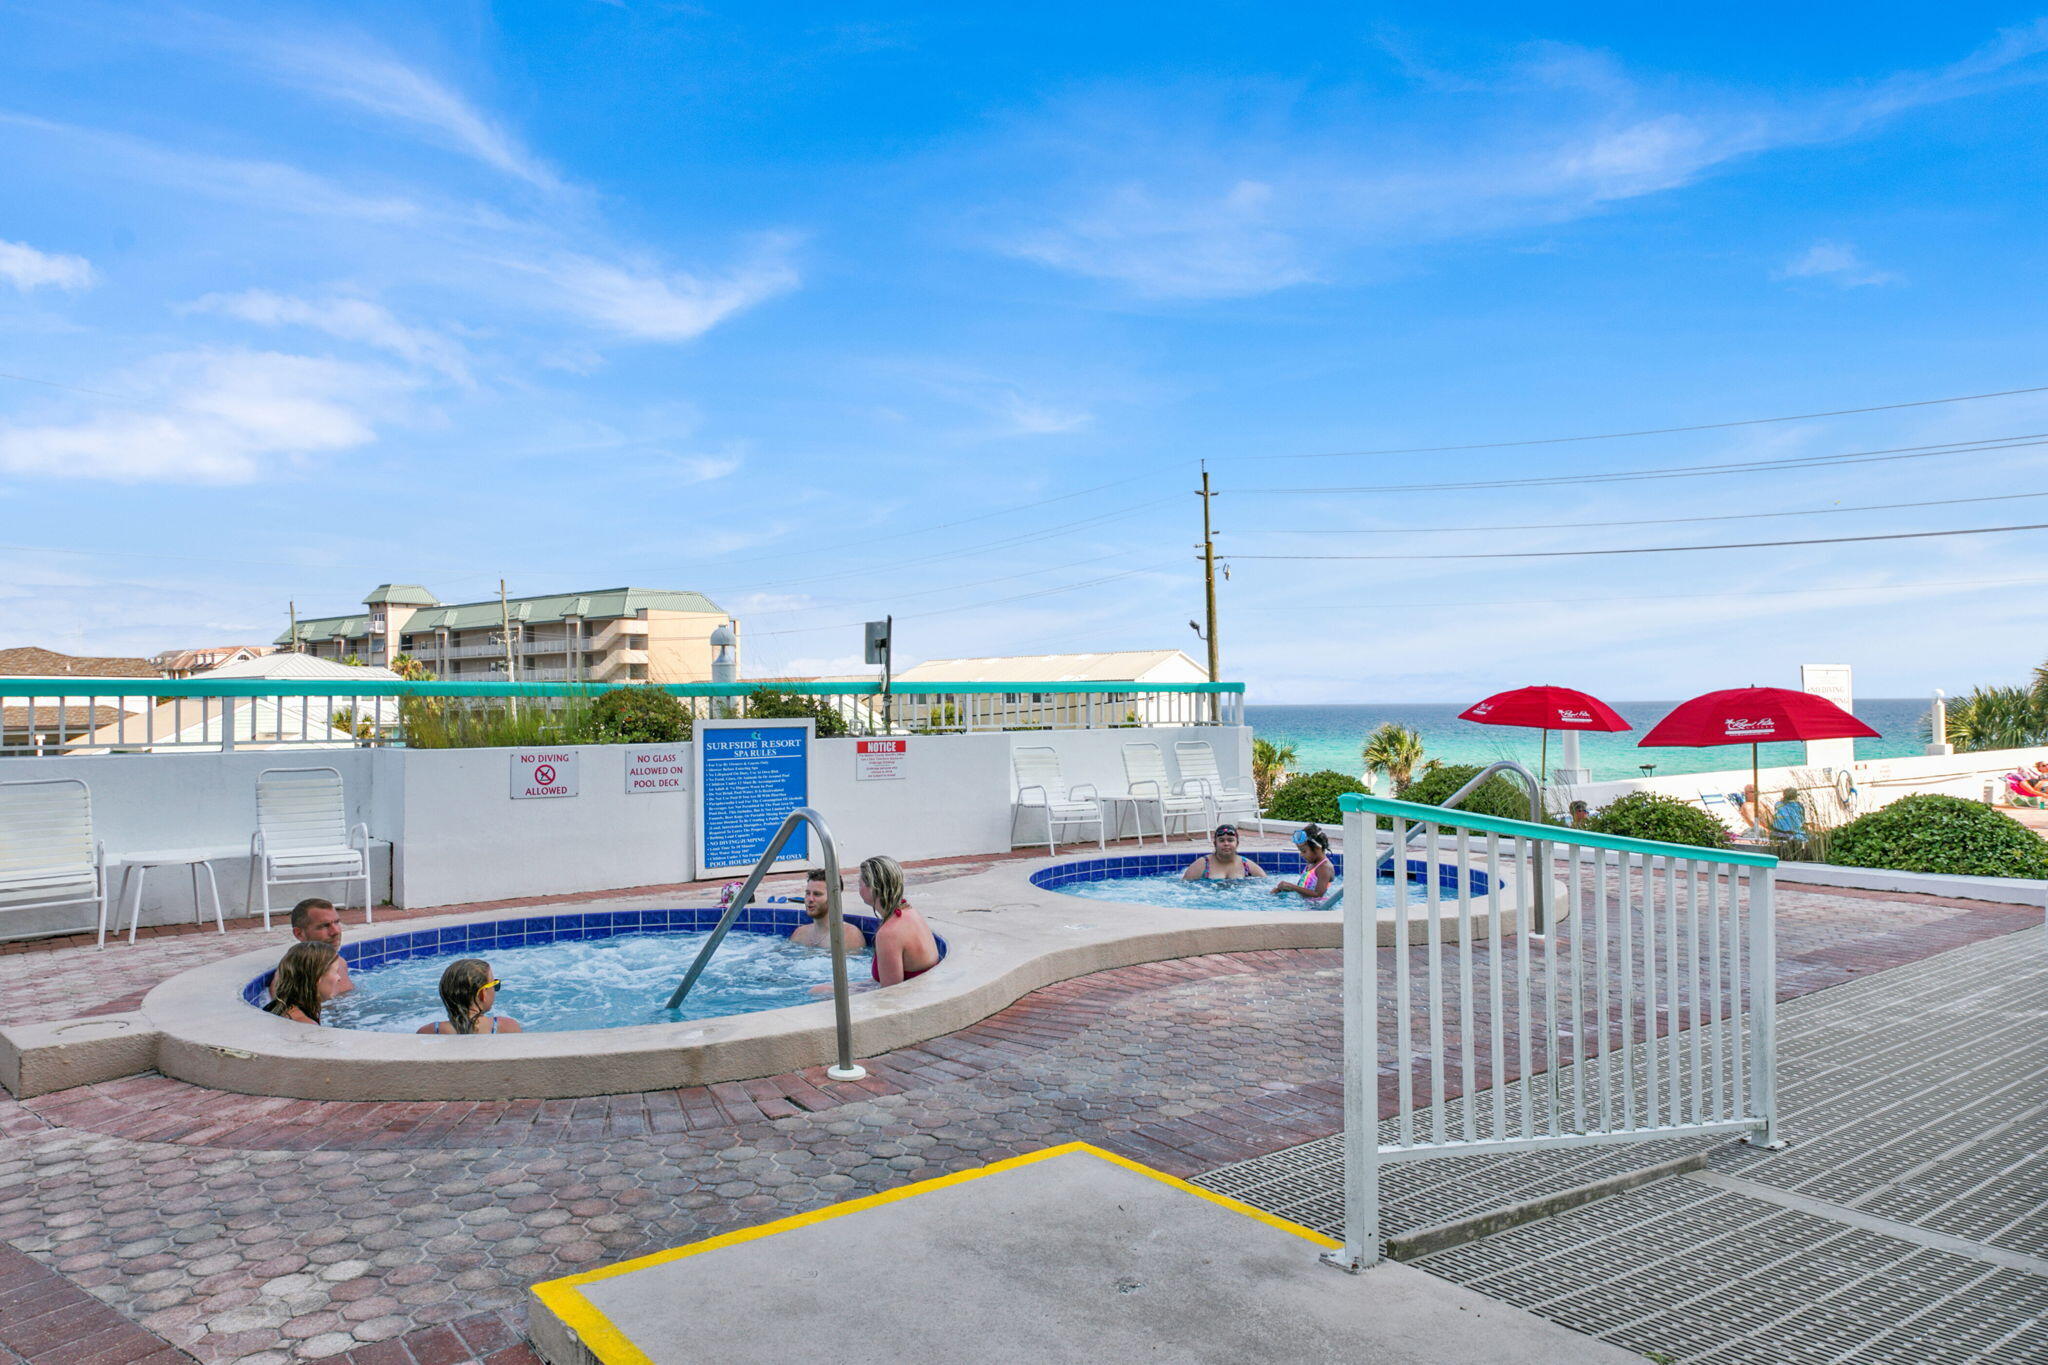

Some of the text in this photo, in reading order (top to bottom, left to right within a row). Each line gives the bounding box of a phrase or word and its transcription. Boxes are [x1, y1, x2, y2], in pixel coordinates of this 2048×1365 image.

[706, 739, 802, 751] SURFSIDE RESORT
[867, 741, 897, 753] NOTICE
[520, 753, 570, 763] NO DIVING
[637, 753, 677, 763] NO GLASS
[734, 748, 777, 758] SPA RULES
[629, 766, 683, 776] ALLOWED ON
[633, 778, 679, 788] POOL DECK
[525, 786, 568, 796] ALLOWED
[728, 858, 752, 867] HOURS
